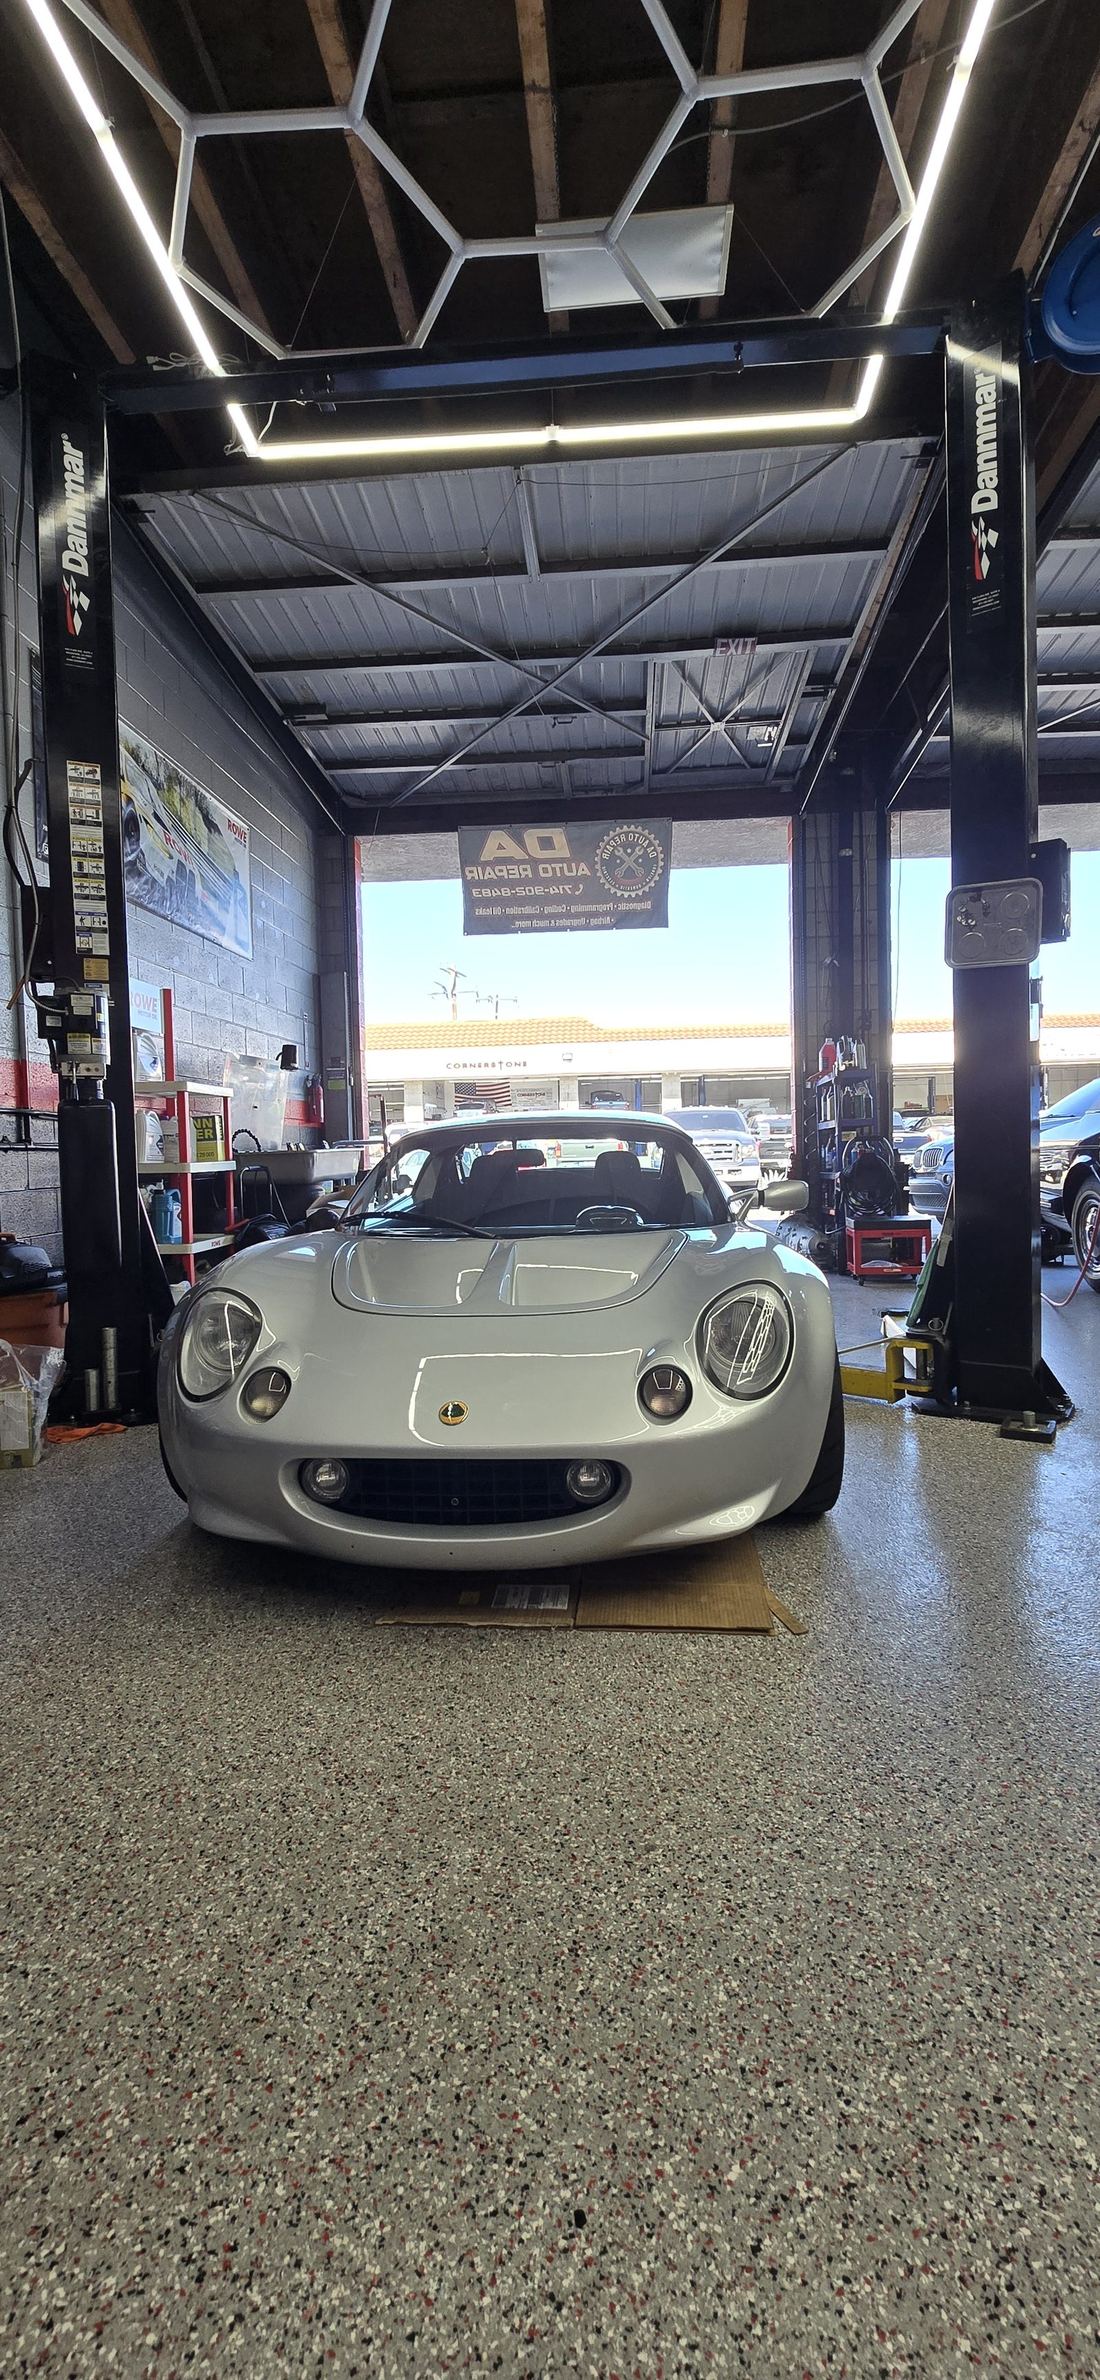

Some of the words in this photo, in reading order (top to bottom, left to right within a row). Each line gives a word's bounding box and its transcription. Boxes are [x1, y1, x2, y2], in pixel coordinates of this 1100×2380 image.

[971, 373, 998, 514] Dannmar
[61, 440, 89, 577] Dannmar
[715, 637, 756, 657] EXIT
[227, 819, 247, 844] ROWE
